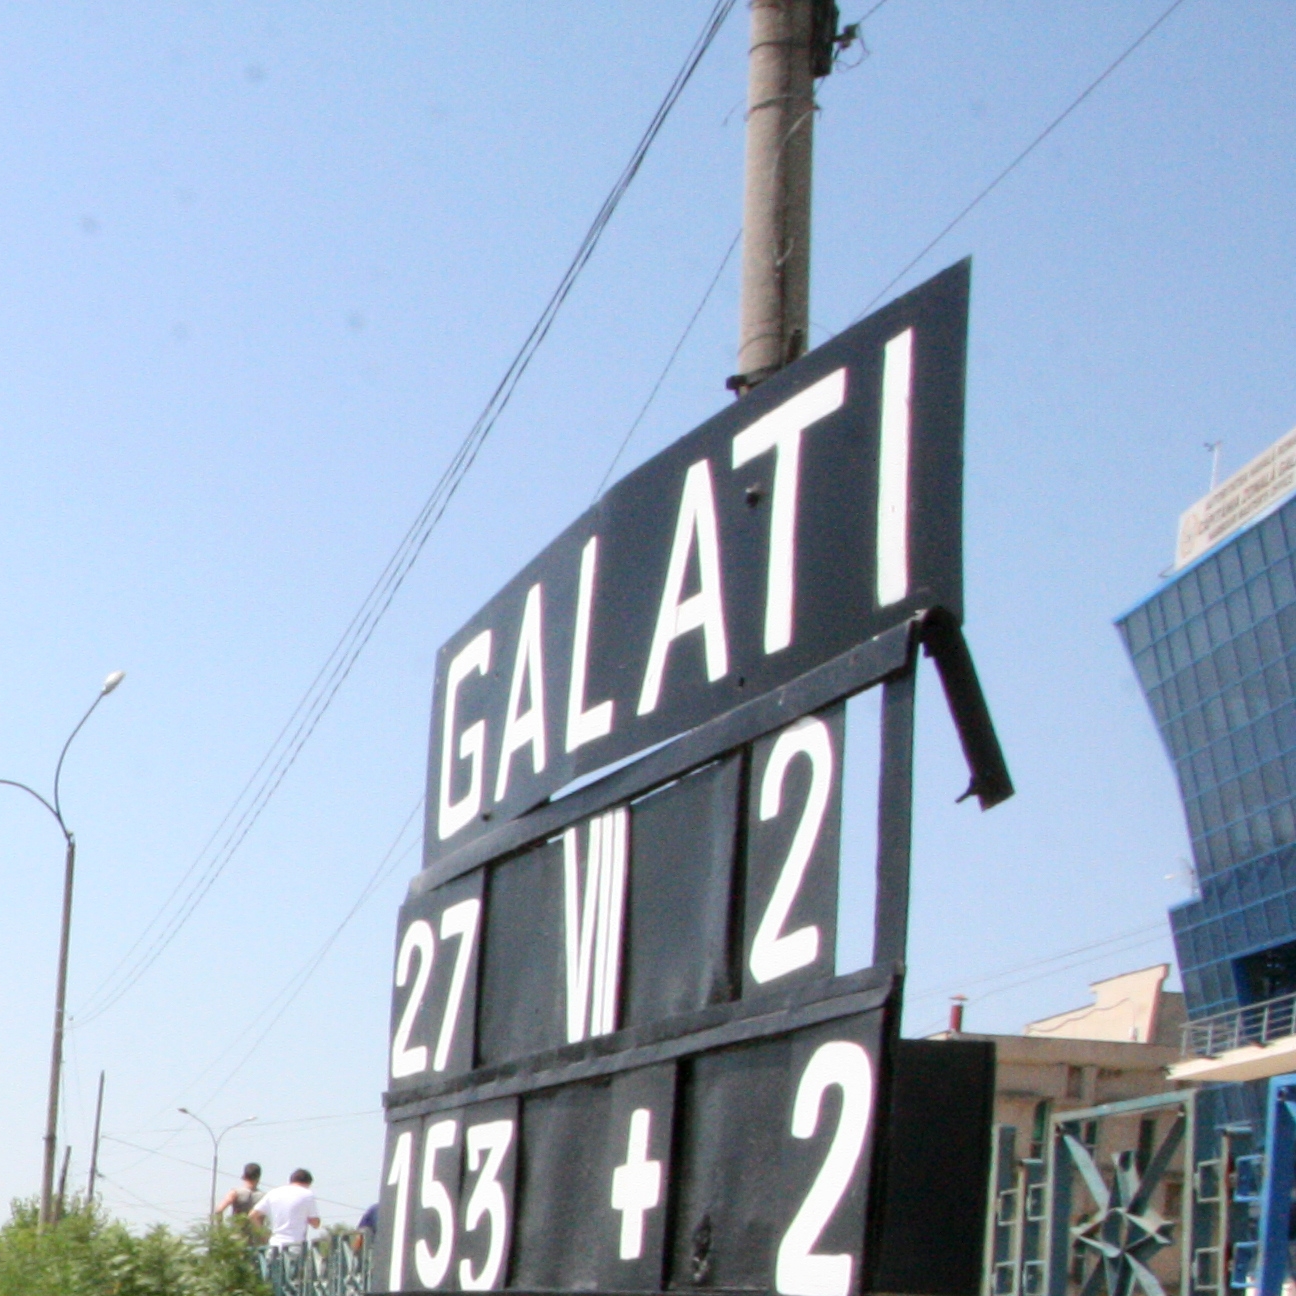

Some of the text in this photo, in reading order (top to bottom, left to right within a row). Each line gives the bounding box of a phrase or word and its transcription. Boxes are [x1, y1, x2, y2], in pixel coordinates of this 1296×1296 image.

[438, 328, 913, 841] GALATI
[391, 898, 480, 1079] 27
[749, 717, 833, 984] 2
[387, 1119, 513, 1292] 153
